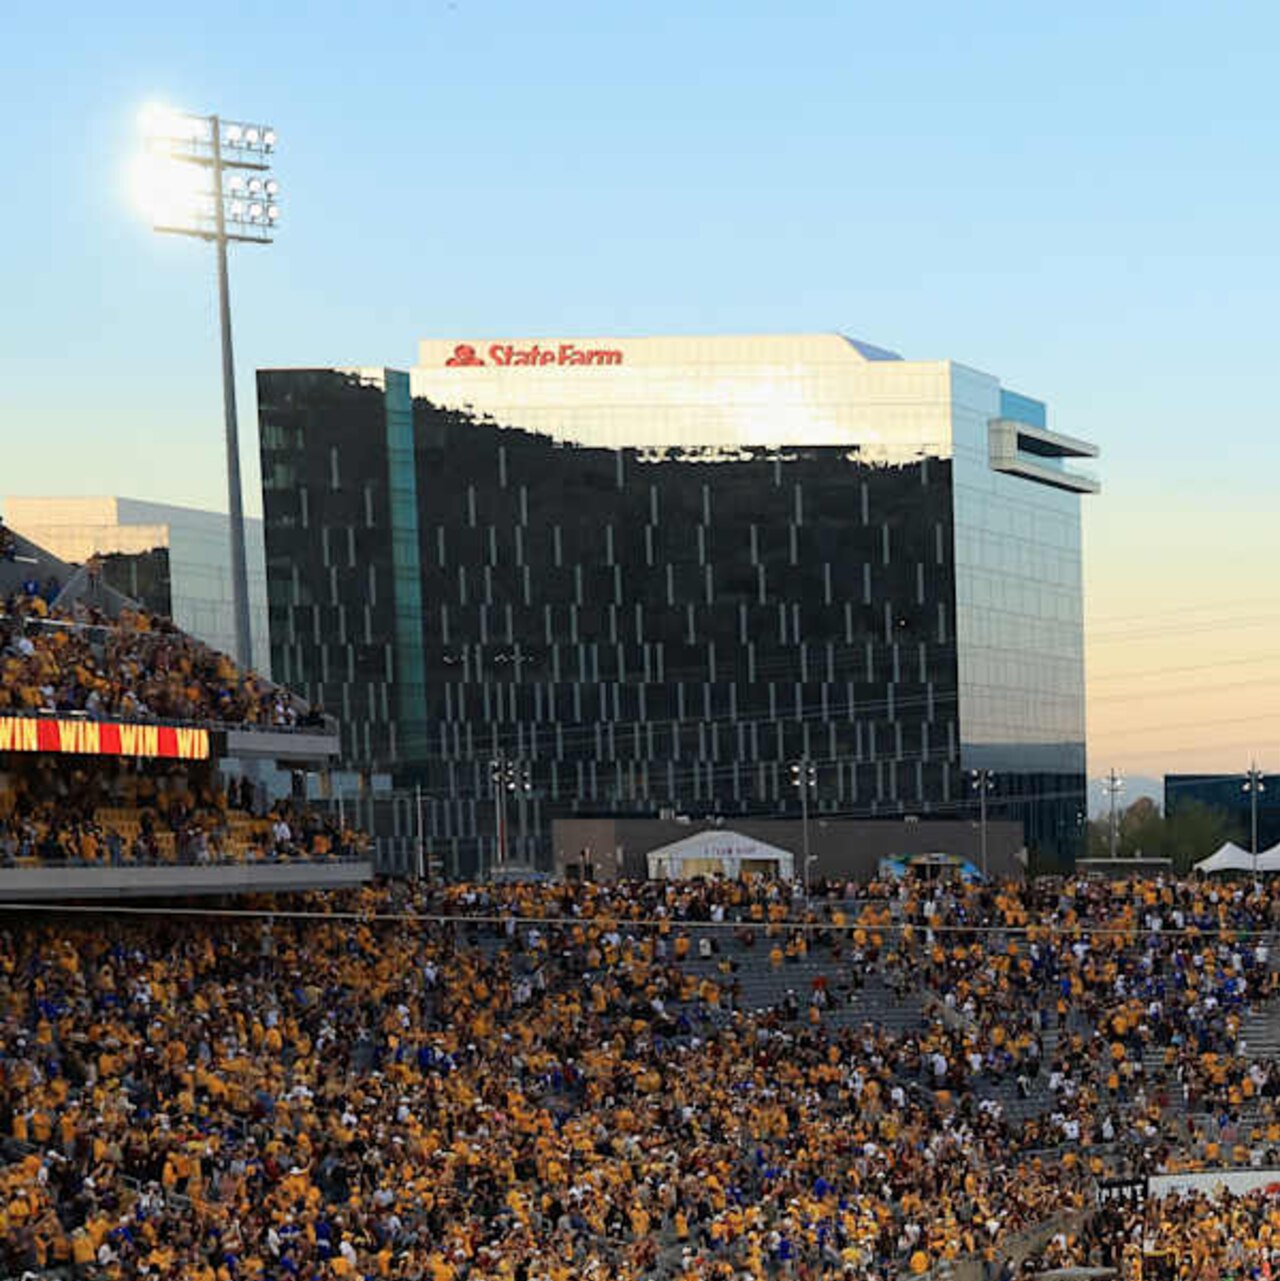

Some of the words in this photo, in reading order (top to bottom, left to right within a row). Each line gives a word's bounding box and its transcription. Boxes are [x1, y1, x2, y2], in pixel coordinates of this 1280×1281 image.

[488, 344, 555, 366] State
[558, 344, 623, 366] Farm
[57, 719, 100, 755] WIN
[119, 723, 158, 757] WIN
